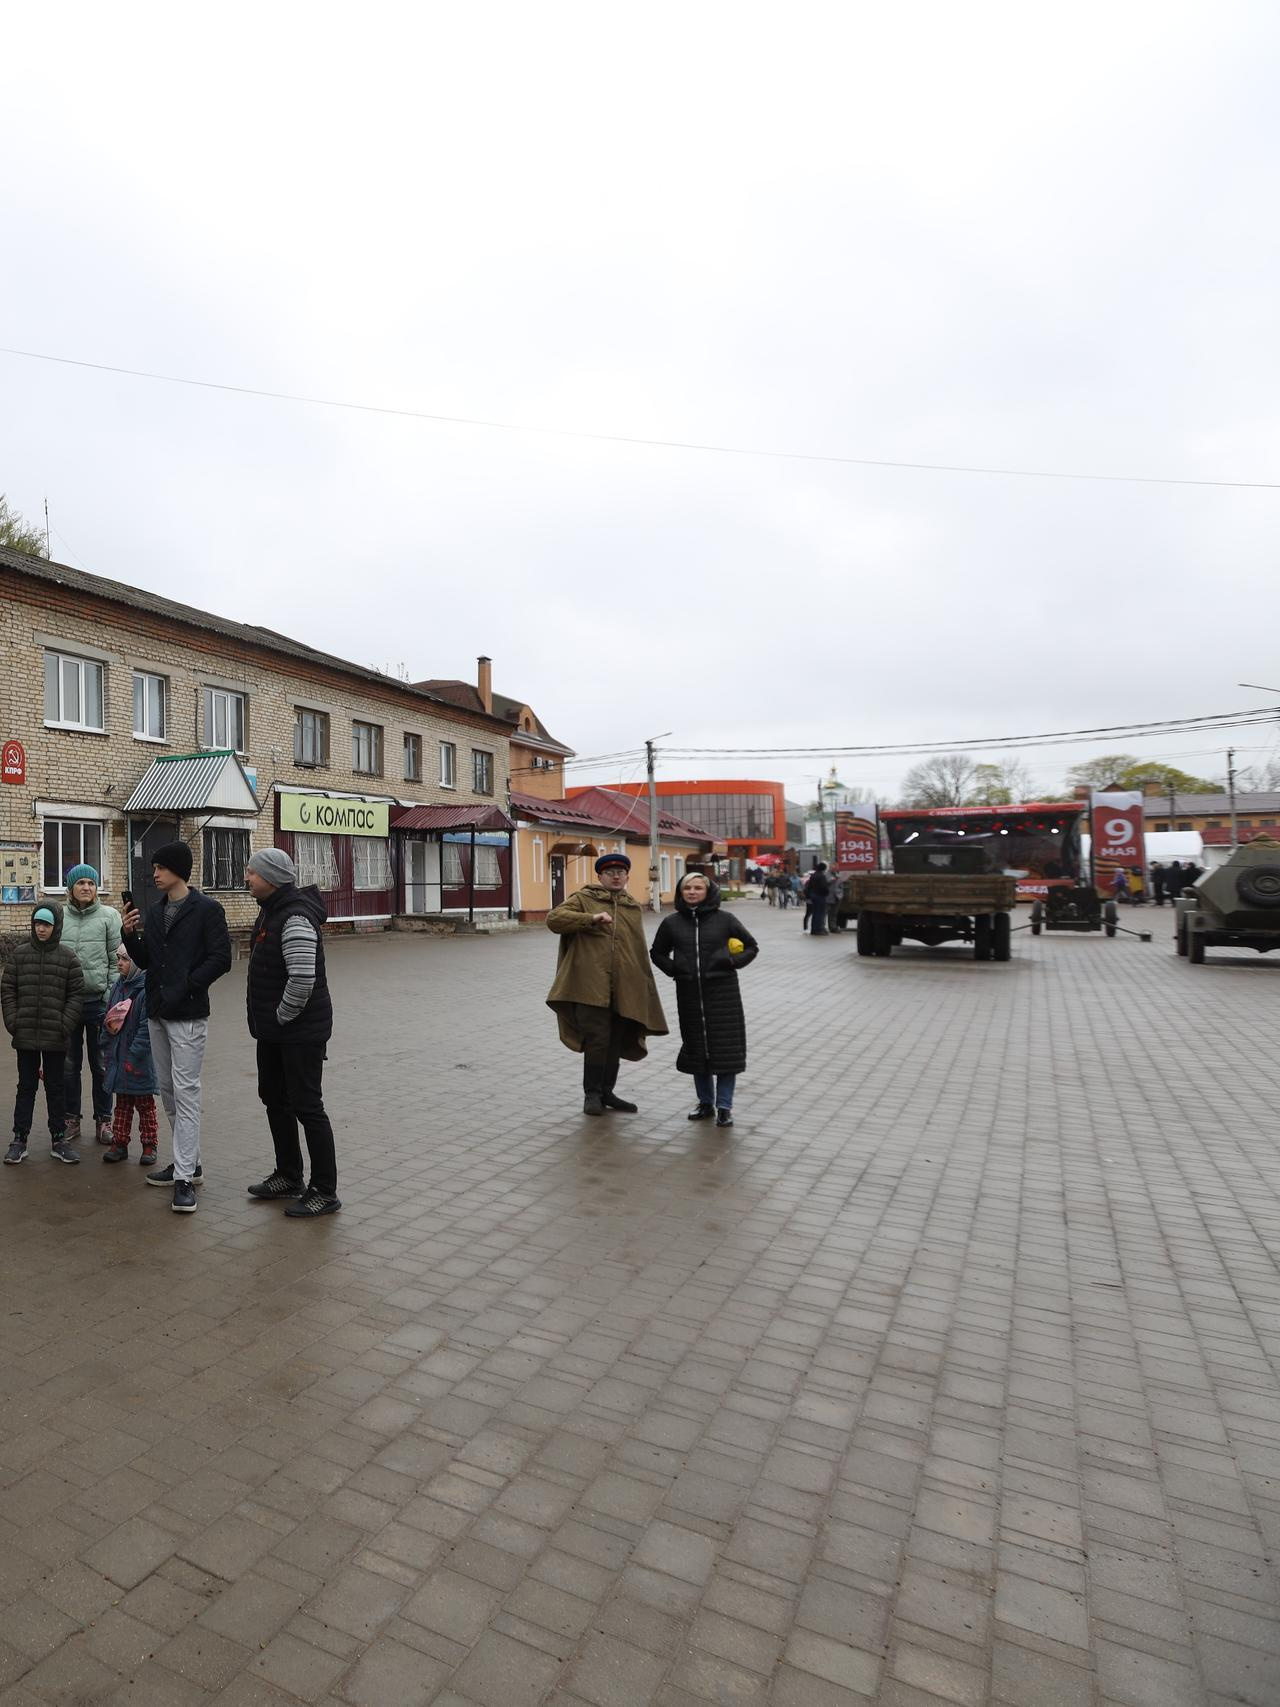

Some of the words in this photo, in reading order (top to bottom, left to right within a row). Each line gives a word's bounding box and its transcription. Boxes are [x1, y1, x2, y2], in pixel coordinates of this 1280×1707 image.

[5, 766, 22, 775] КПРФ
[1104, 818, 1134, 846] 9
[839, 840, 873, 851] 1941
[1101, 847, 1137, 856] МАЯ
[841, 852, 874, 863] 1945
